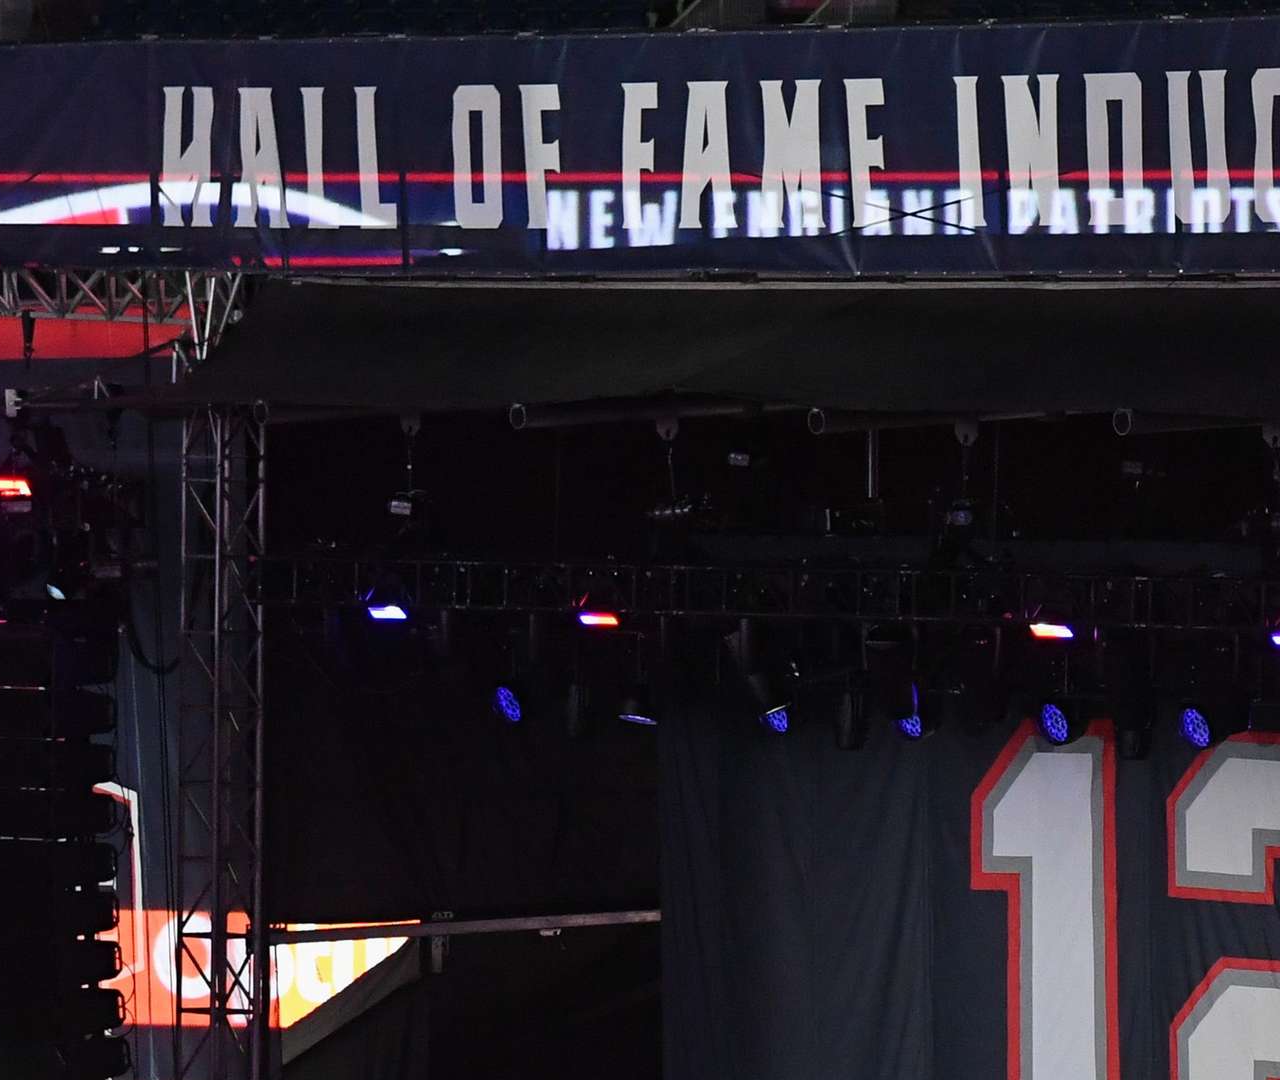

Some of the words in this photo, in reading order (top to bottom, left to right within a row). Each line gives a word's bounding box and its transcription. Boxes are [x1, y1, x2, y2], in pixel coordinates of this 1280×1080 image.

[162, 85, 397, 230] HALL
[452, 83, 562, 230] OF
[620, 77, 886, 230] FAME
[546, 189, 677, 250] NEW
